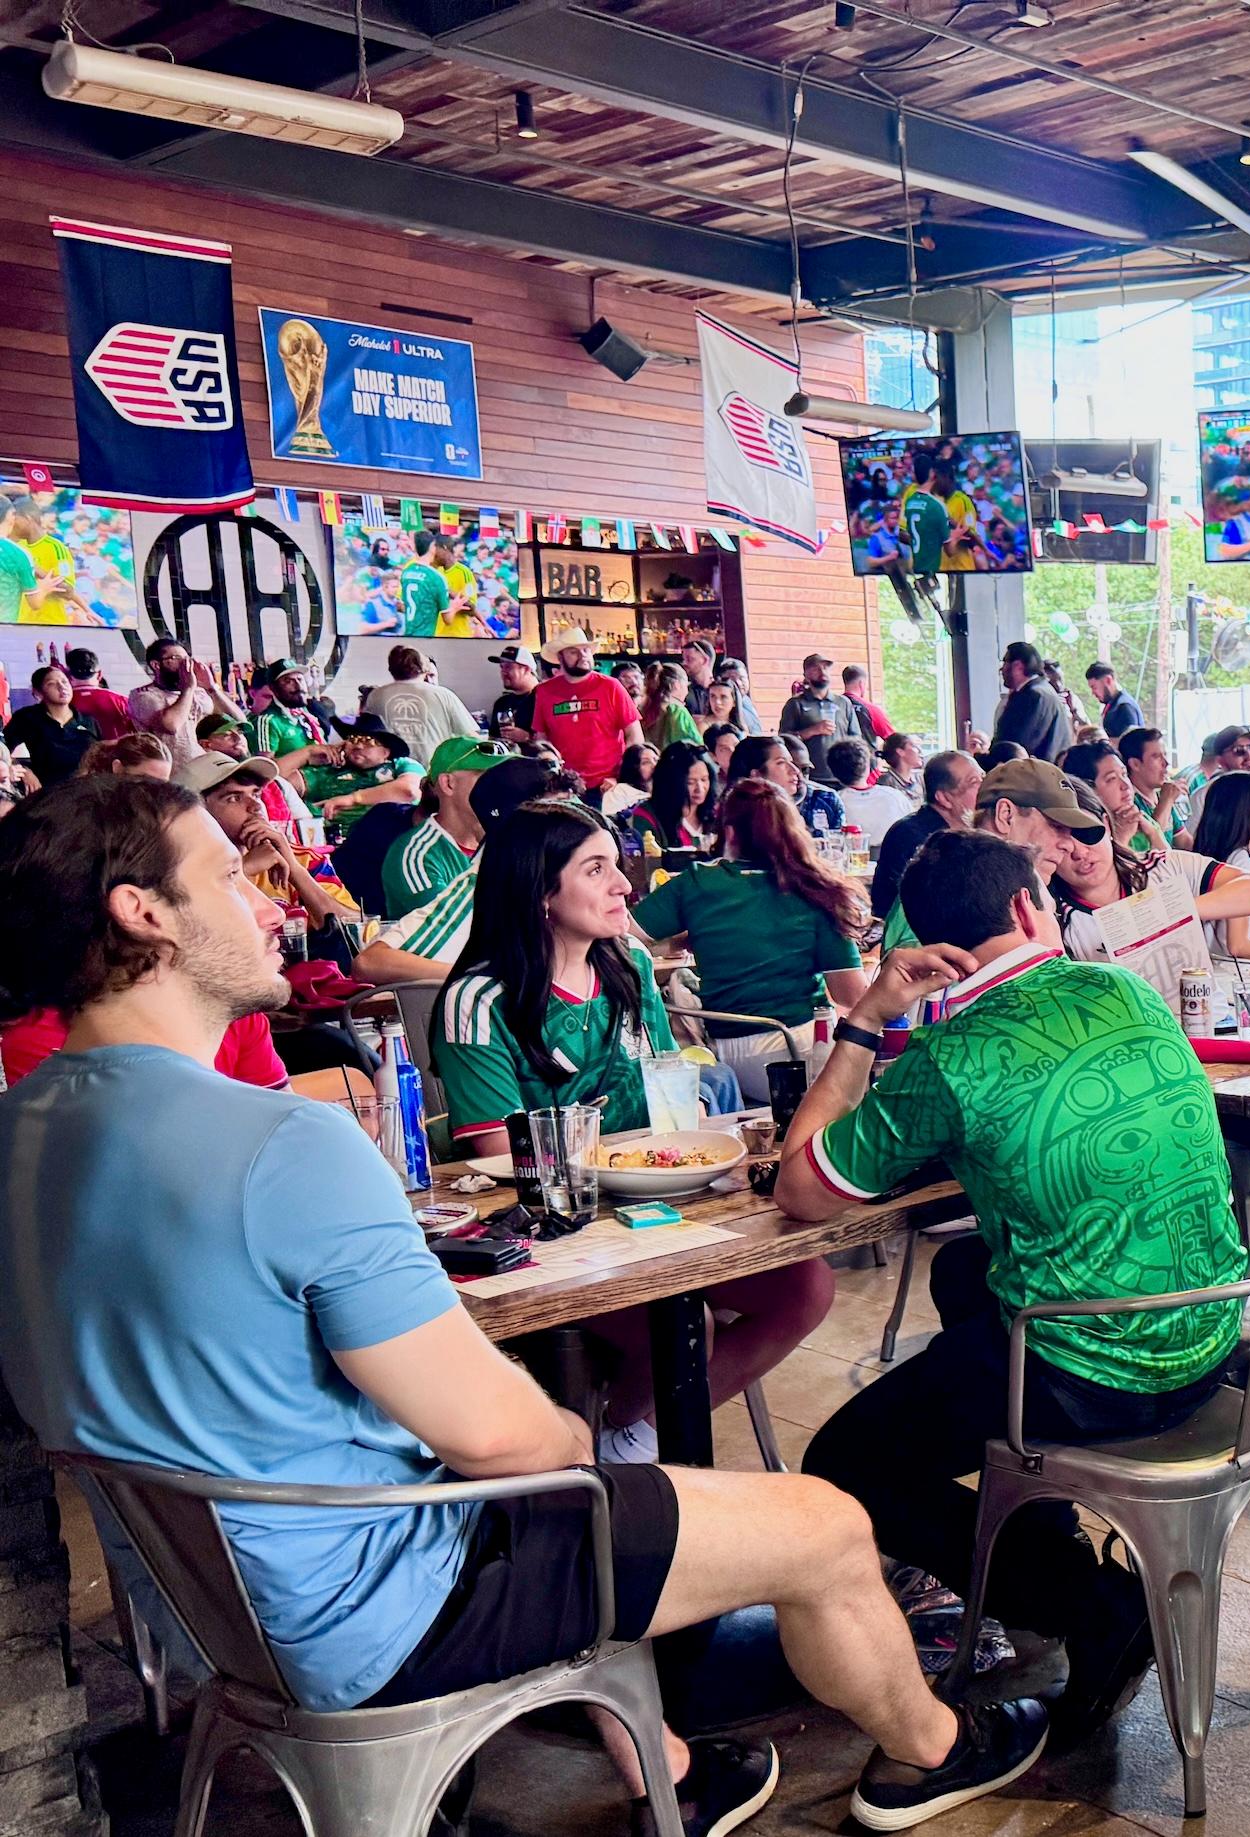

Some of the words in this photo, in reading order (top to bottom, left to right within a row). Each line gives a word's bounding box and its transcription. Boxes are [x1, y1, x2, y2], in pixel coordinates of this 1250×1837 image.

[348, 333, 392, 352] Michelob
[402, 343, 444, 361] ULTRA
[169, 338, 227, 423] USA
[353, 367, 396, 396] MAKE
[397, 374, 446, 404] MATCH
[352, 390, 381, 417] DAY
[384, 395, 453, 427] SUPERIOR
[767, 418, 803, 477] USA
[547, 562, 602, 600] BAR
